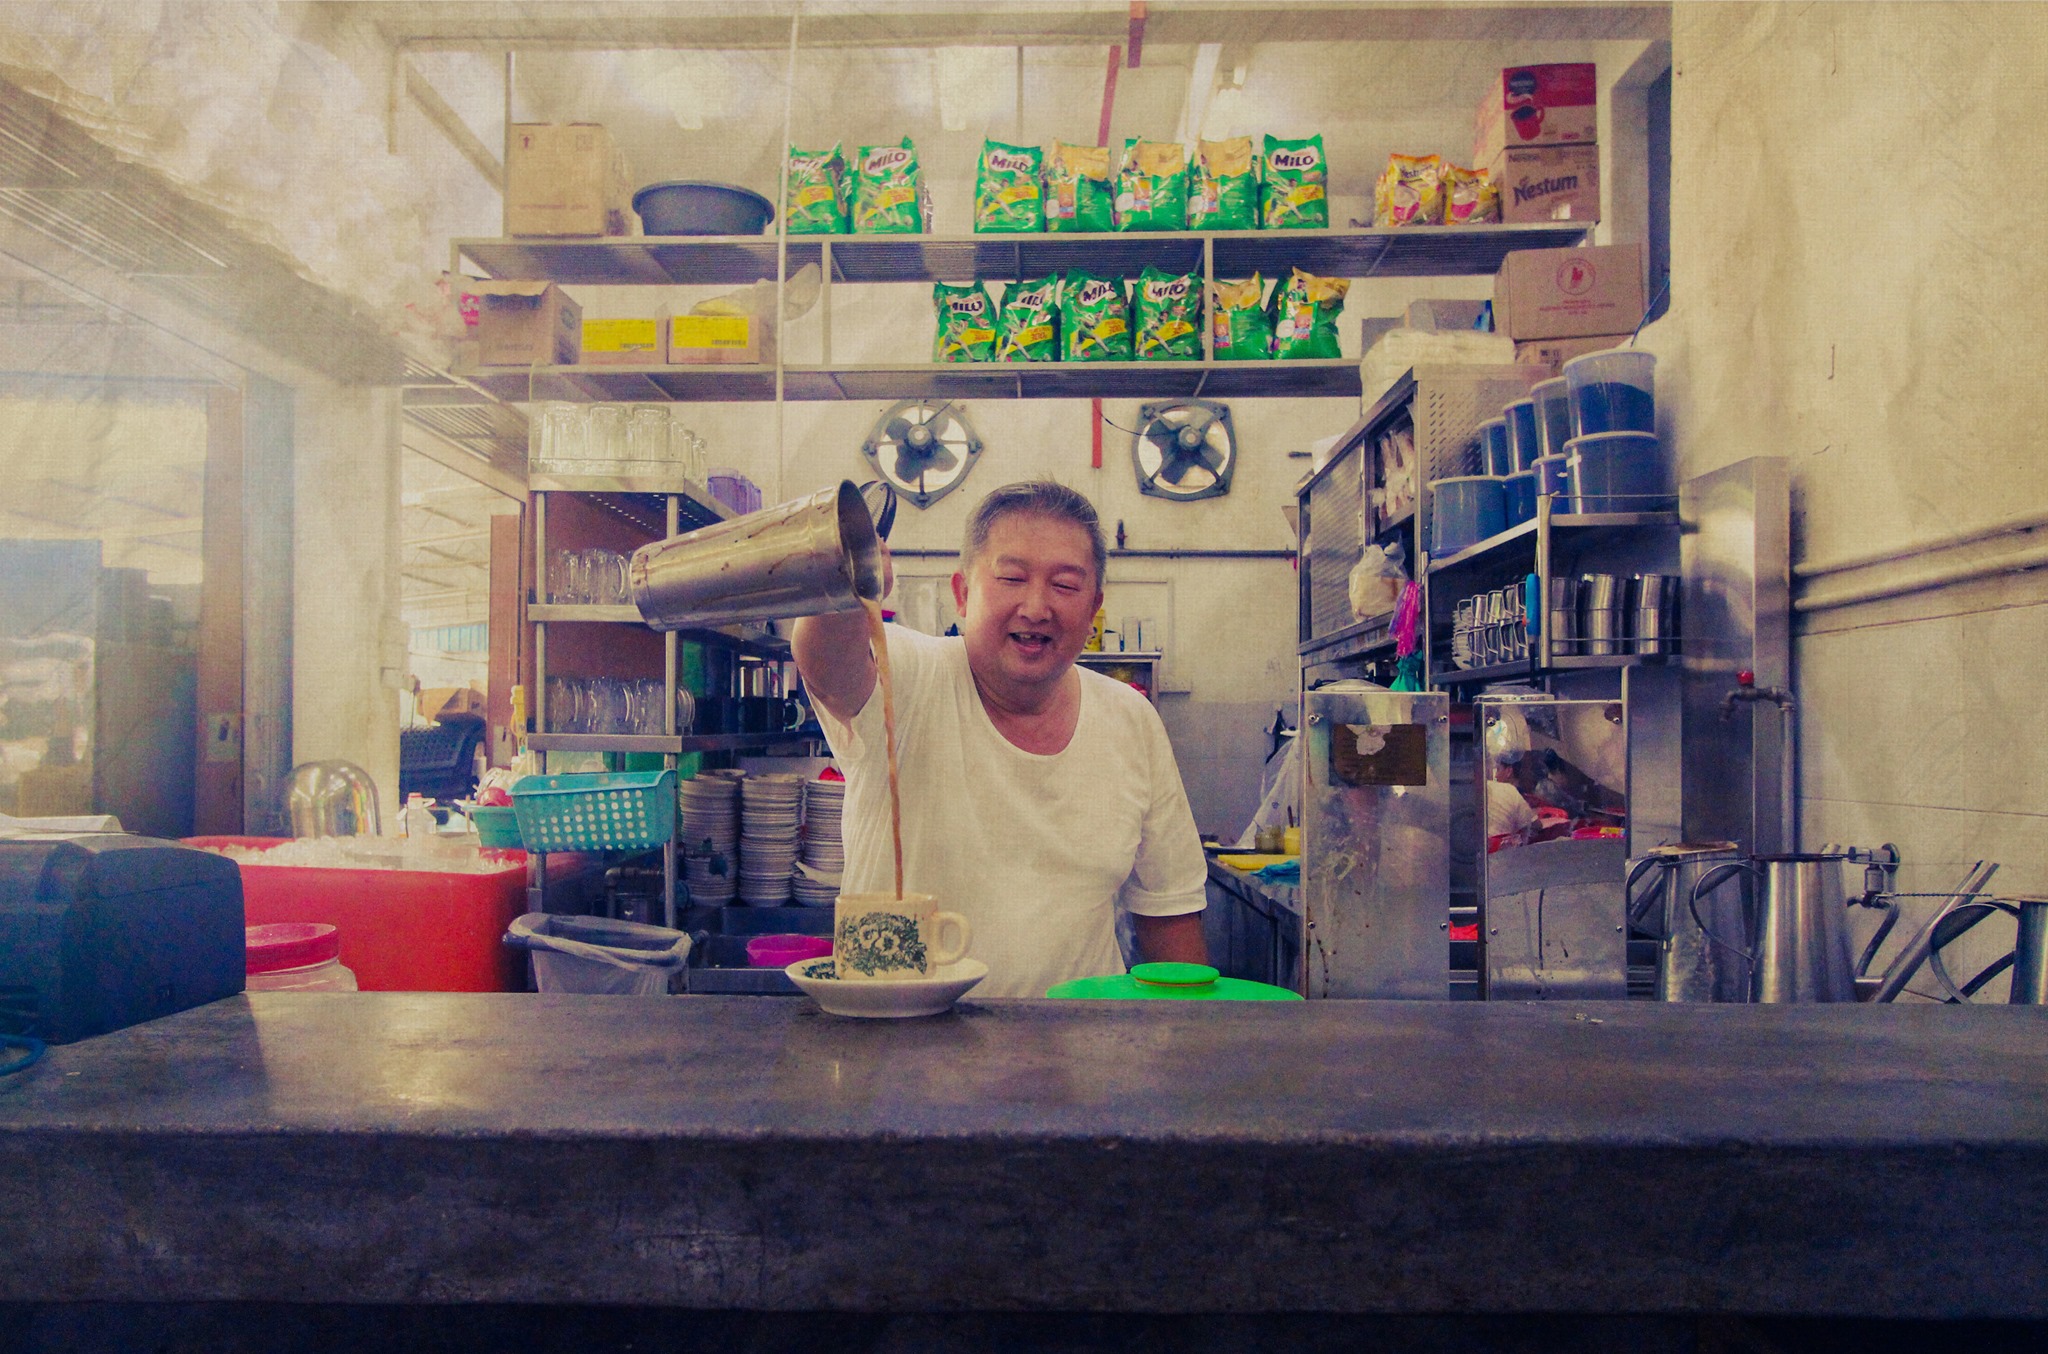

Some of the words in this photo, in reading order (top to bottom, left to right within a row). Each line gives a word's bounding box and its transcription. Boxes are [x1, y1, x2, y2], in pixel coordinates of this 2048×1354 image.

[868, 152, 907, 171] MILO
[992, 155, 1029, 173] MILO
[1275, 154, 1314, 167] MILO
[1512, 175, 1578, 206] Nestum
